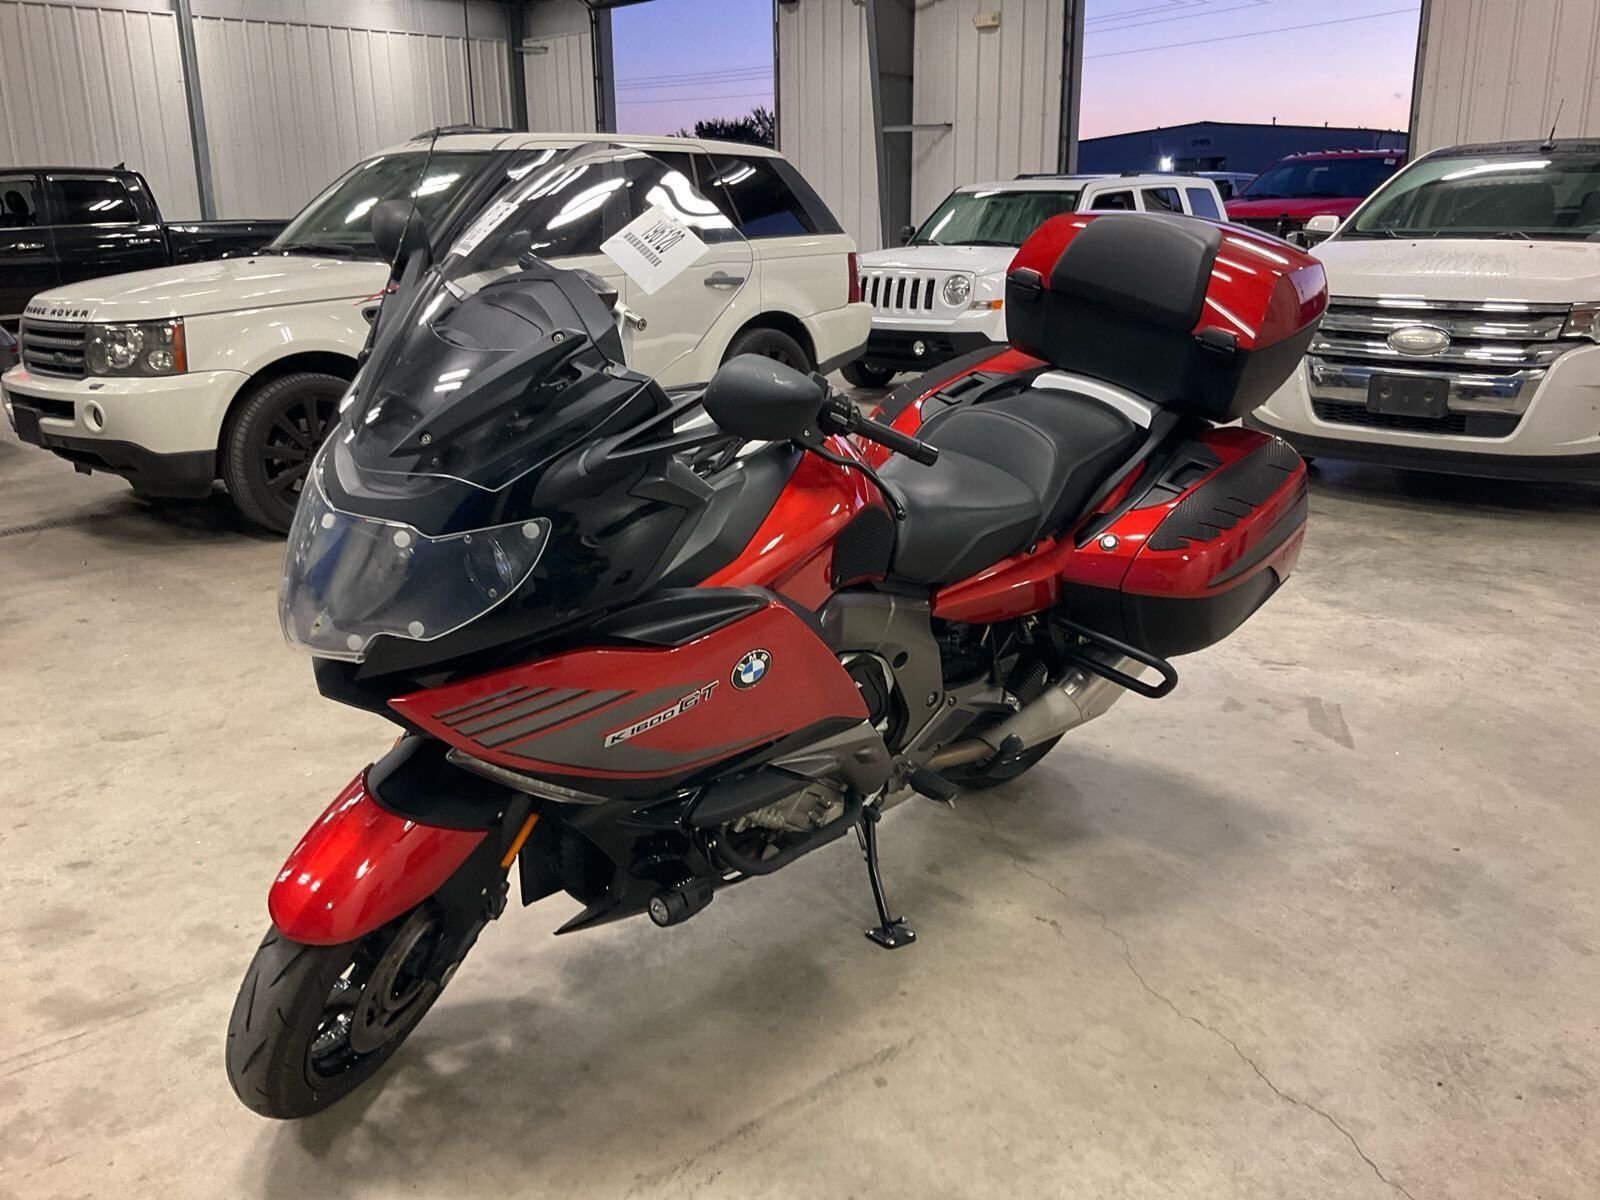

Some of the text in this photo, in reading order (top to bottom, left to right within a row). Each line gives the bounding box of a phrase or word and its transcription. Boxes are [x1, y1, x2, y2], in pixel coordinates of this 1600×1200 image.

[641, 220, 686, 254] 196120
[50, 308, 89, 317] ROVER
[737, 653, 769, 671] BMW
